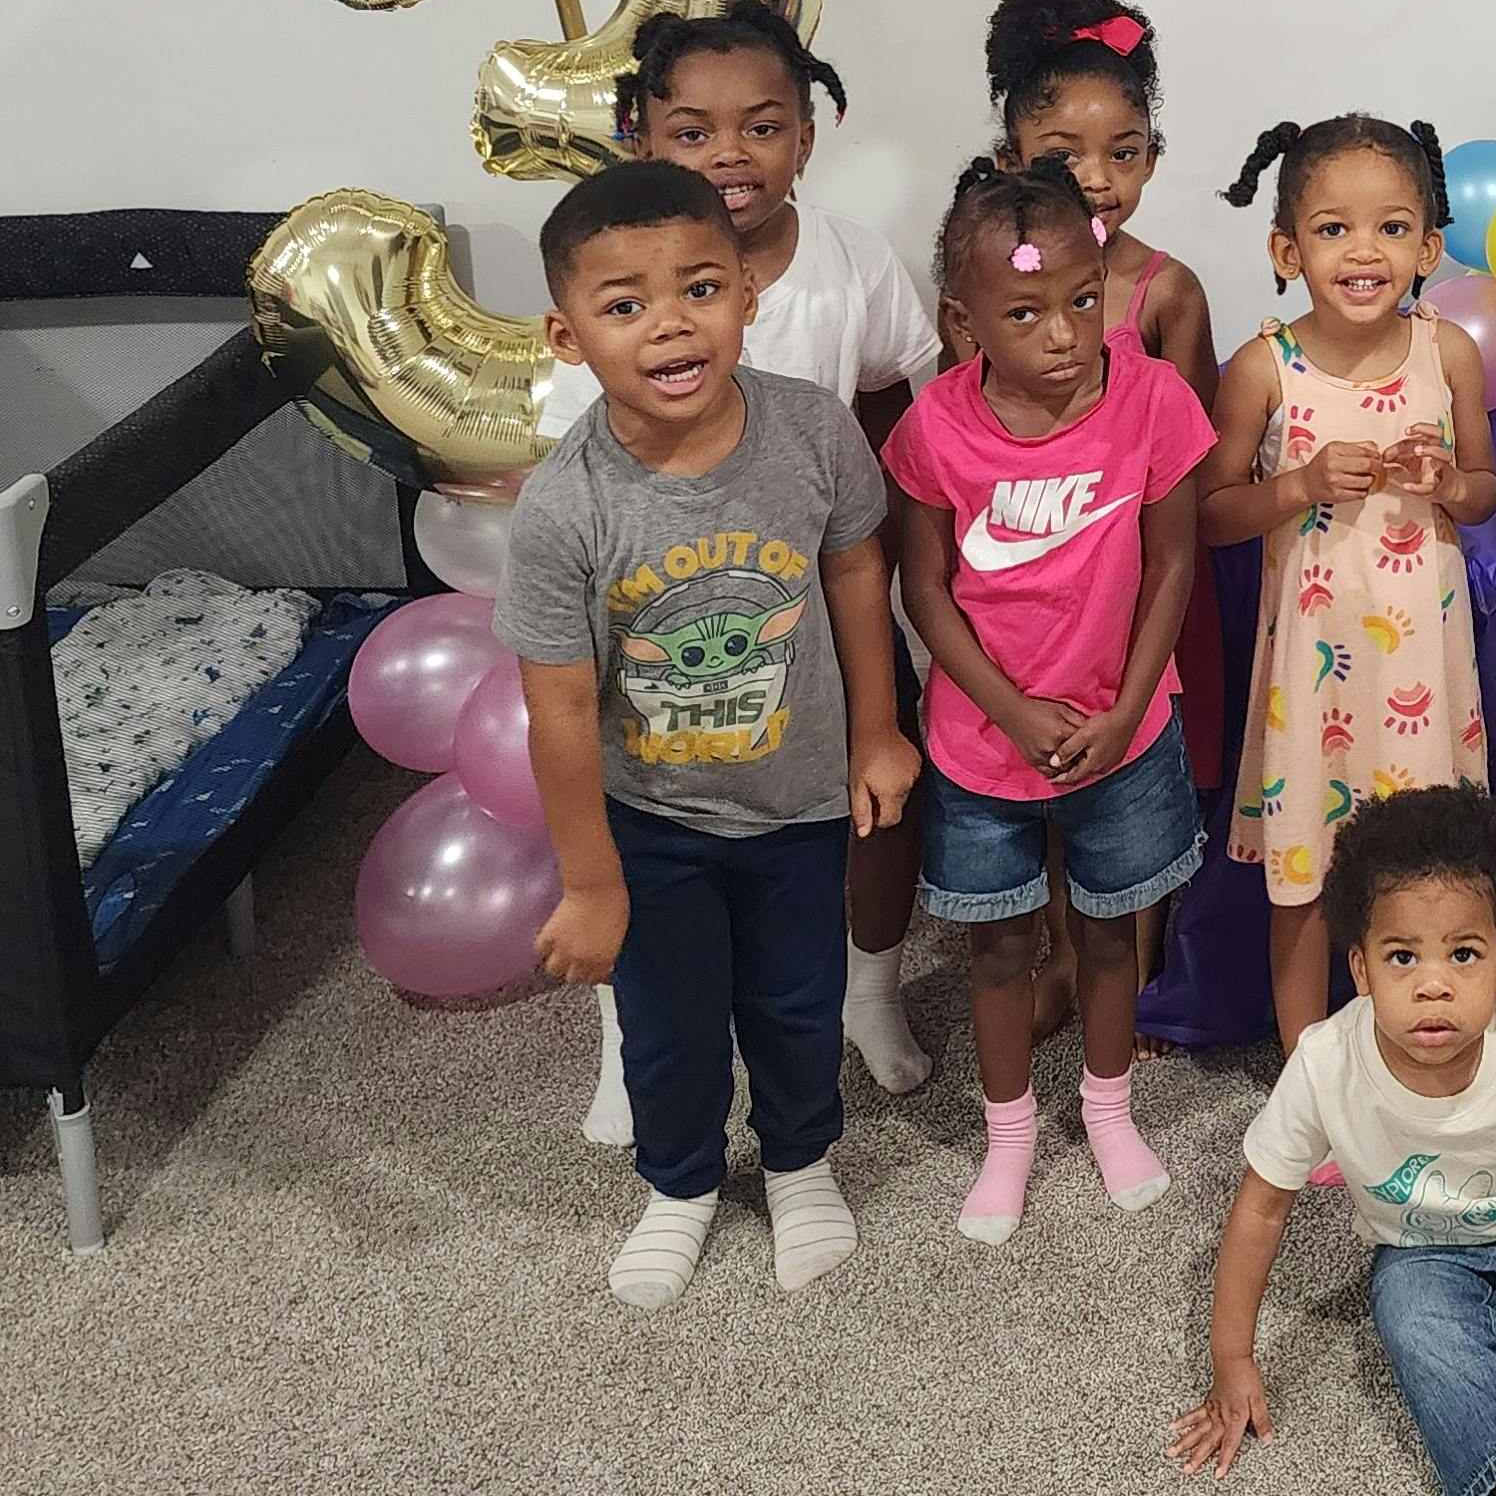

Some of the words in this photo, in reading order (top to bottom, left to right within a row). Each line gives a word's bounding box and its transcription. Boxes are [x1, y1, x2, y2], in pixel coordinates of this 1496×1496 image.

[989, 470, 1104, 534] NIKE
[664, 531, 758, 580] OUT
[758, 539, 809, 582] OF
[660, 689, 767, 732] THIS
